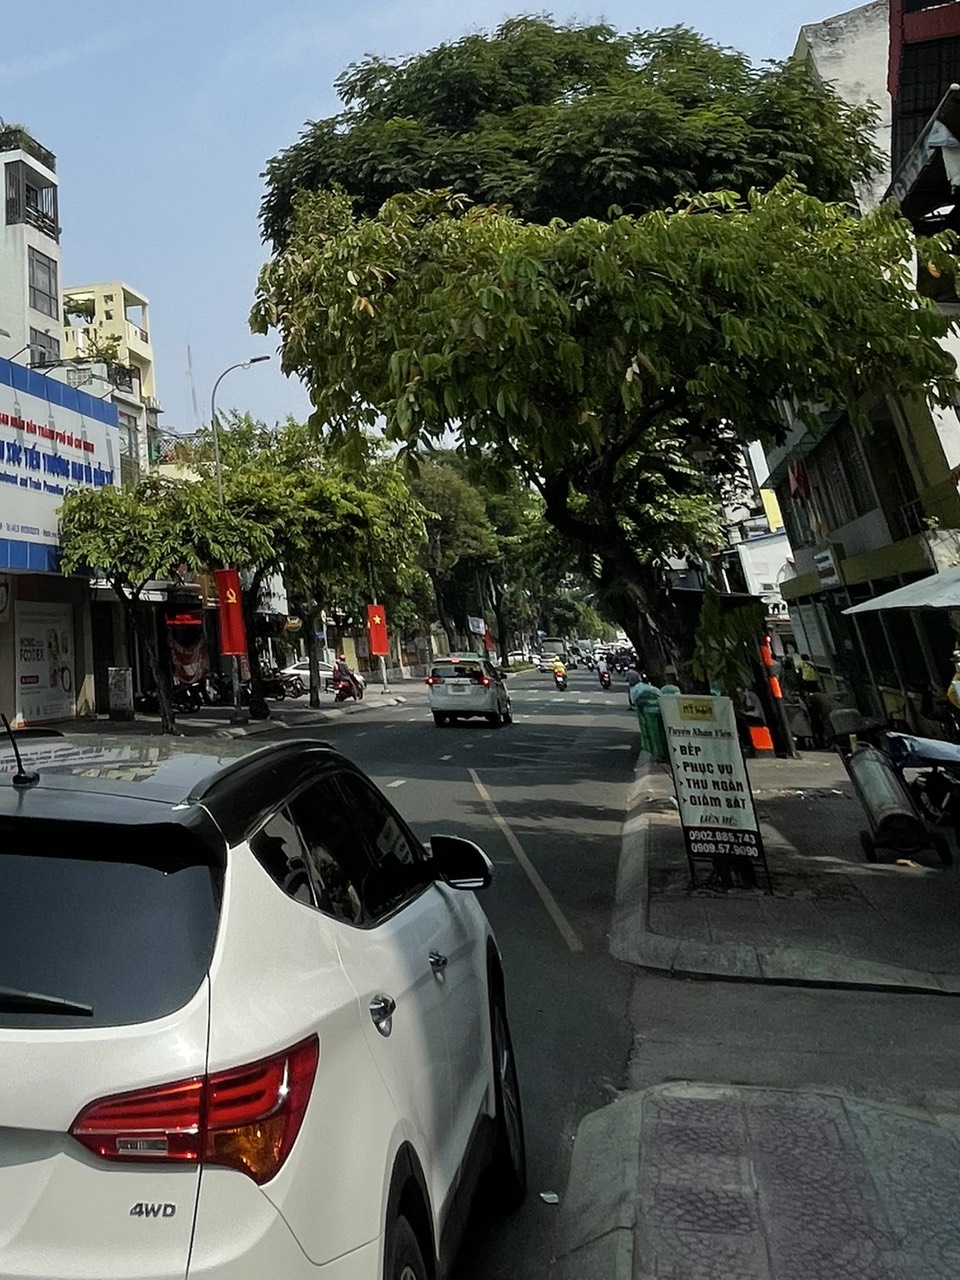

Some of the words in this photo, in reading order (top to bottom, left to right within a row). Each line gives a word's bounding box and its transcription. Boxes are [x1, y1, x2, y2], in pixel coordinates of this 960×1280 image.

[682, 761, 714, 776] PHỤC
[717, 764, 733, 777] VỤ
[686, 778, 708, 790] THU
[725, 796, 746, 810] SÁT
[130, 1203, 176, 1218] 4WD
